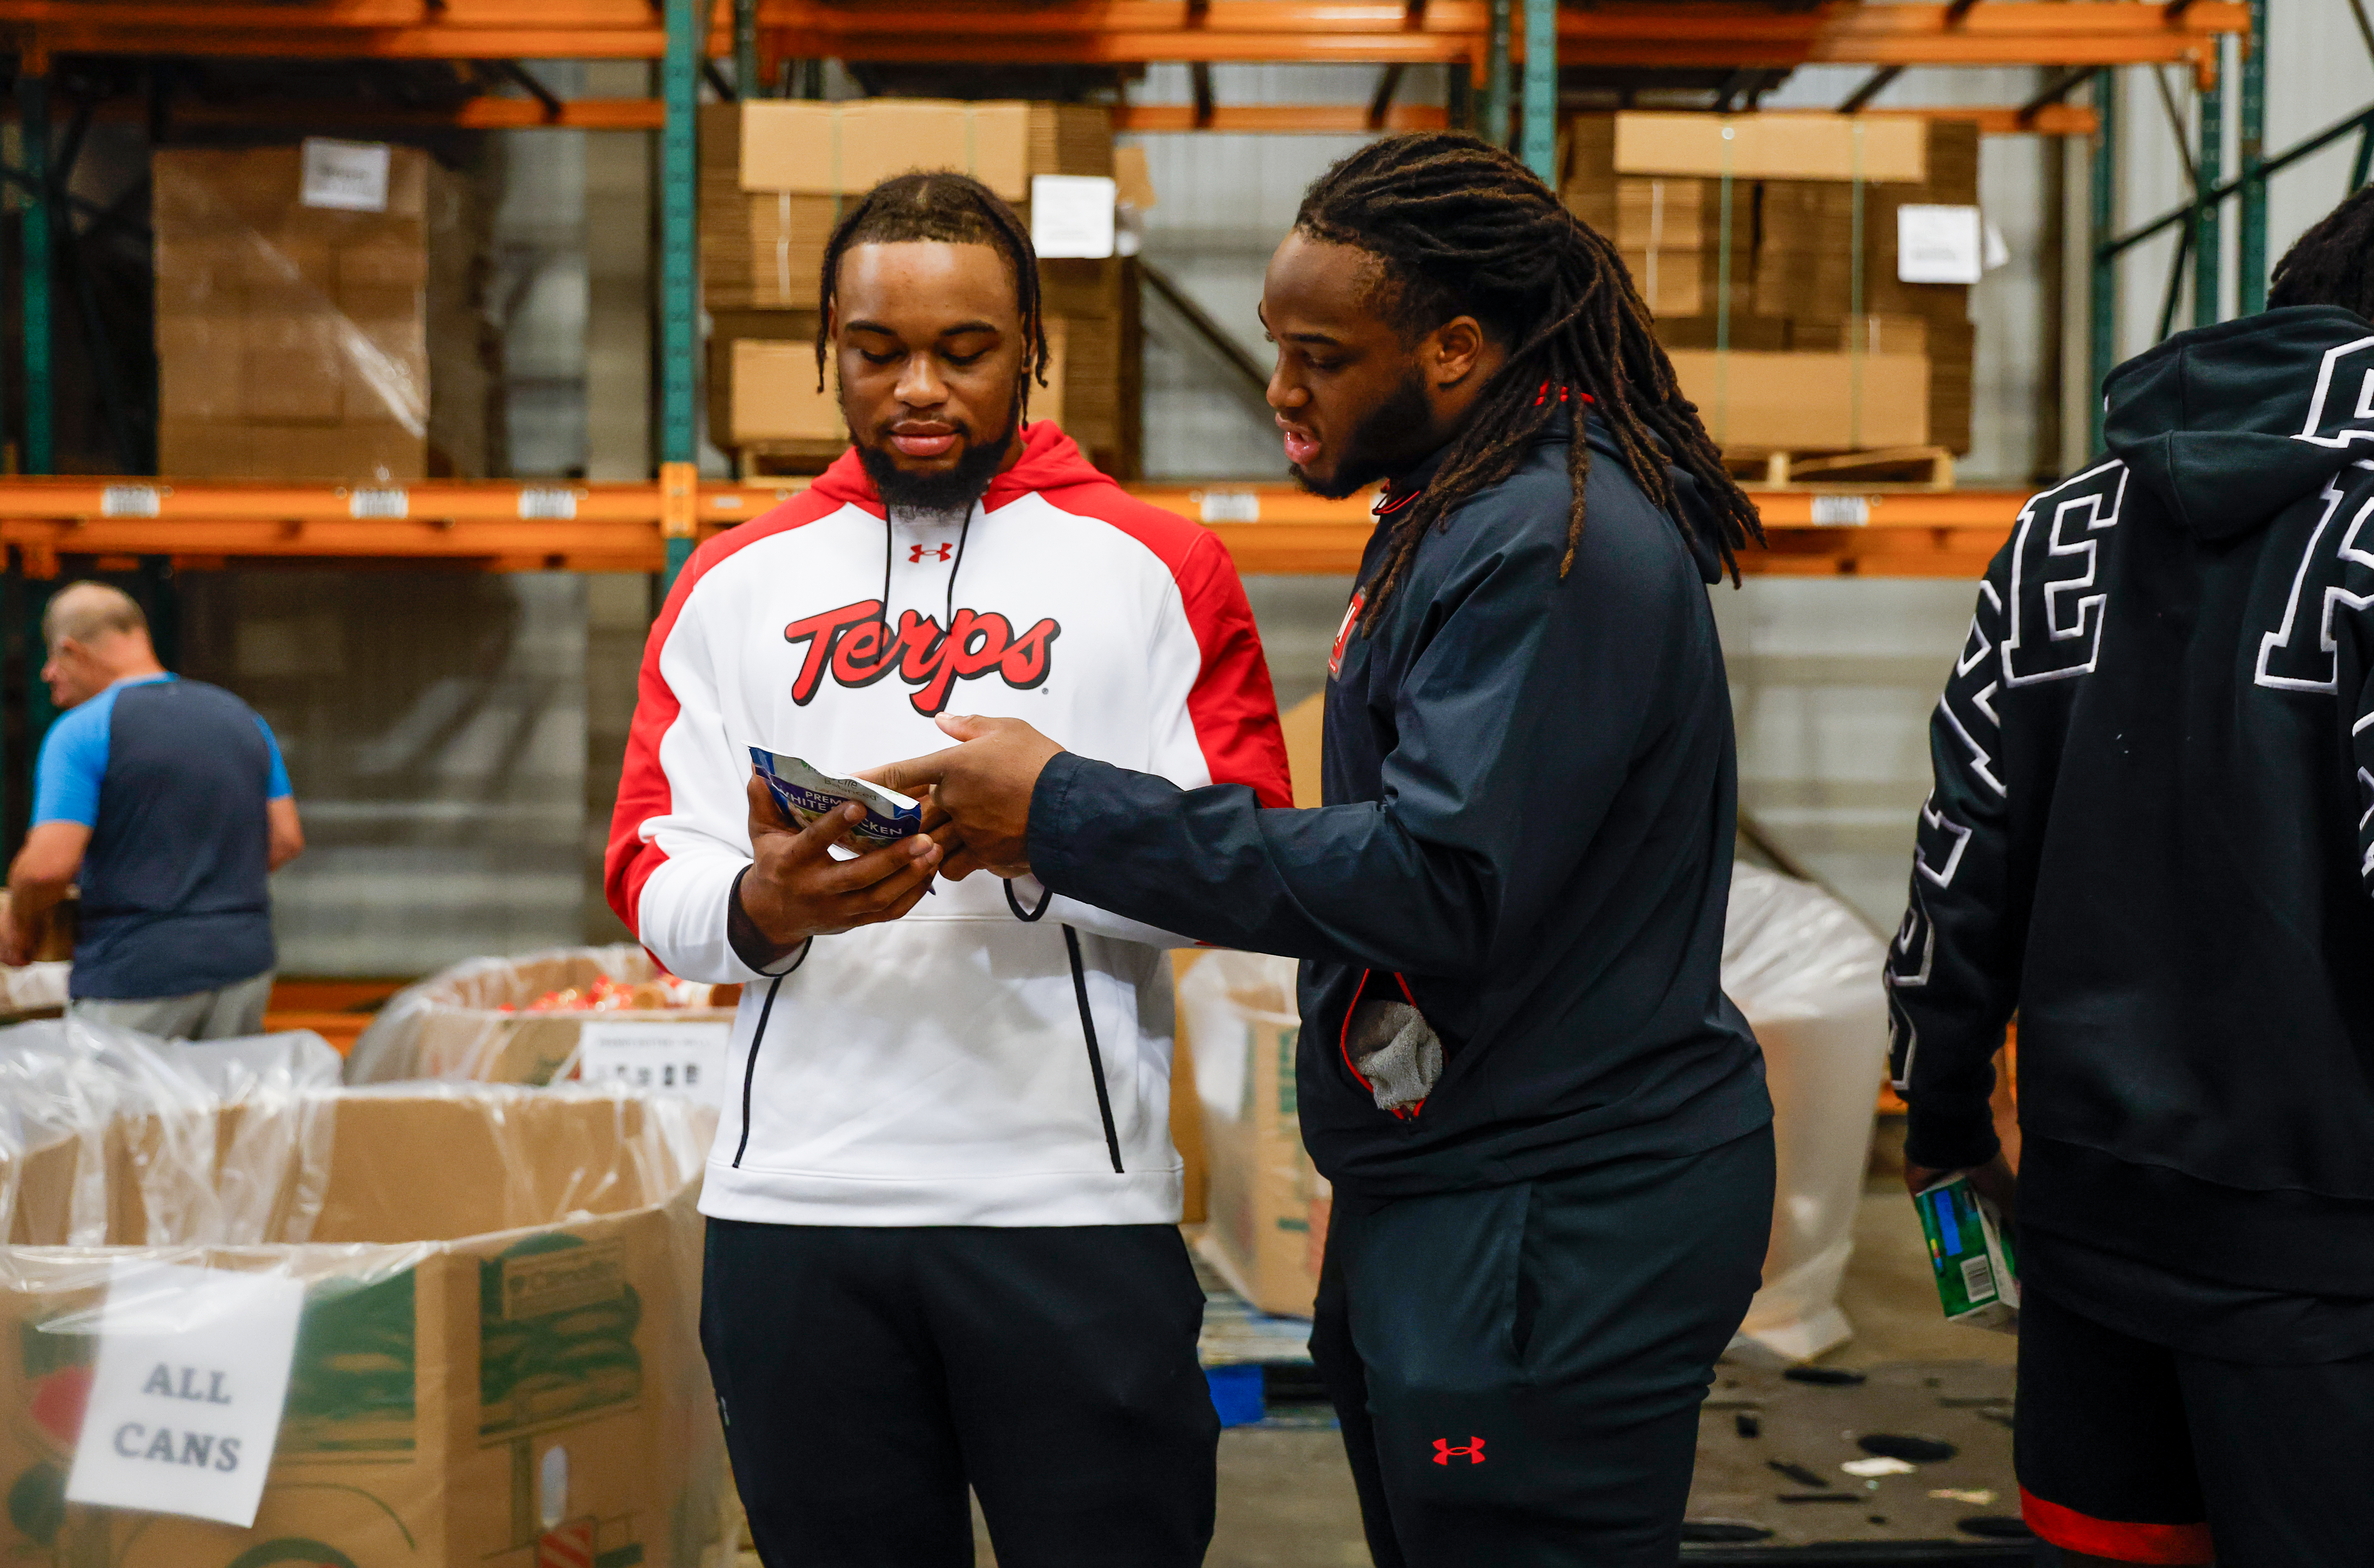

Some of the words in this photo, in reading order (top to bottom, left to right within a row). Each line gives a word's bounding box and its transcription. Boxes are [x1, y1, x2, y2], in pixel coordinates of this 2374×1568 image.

[785, 599, 1061, 717] Terps
[805, 791, 842, 805] PREM
[141, 1361, 232, 1405] ALL
[113, 1421, 242, 1473] CANS
